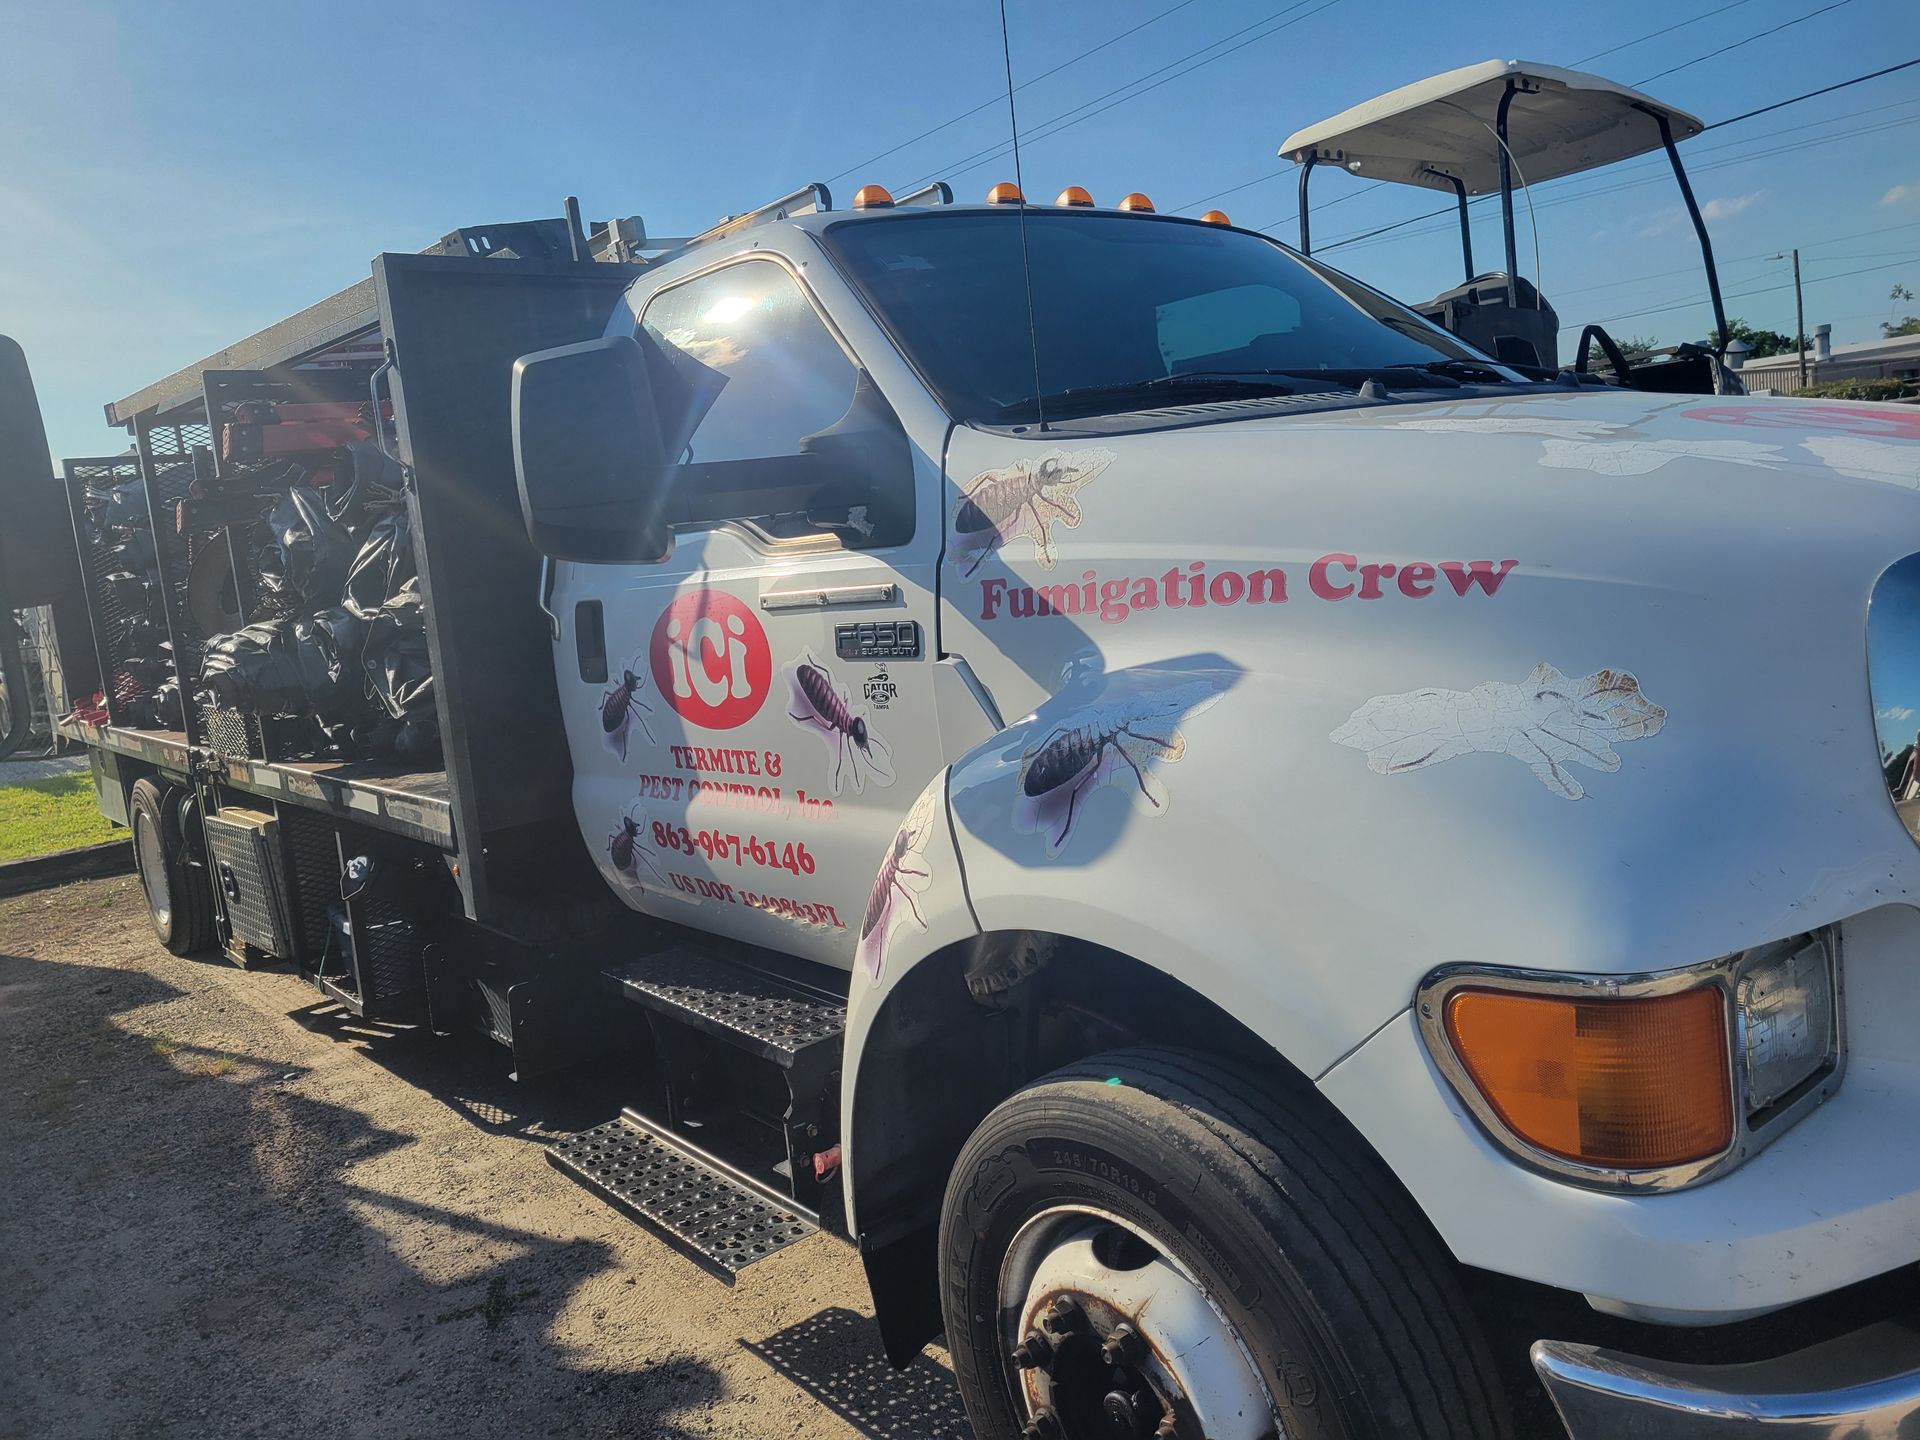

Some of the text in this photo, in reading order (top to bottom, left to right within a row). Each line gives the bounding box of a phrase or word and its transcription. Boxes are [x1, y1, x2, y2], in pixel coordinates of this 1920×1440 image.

[980, 553, 1519, 624] Fumigation Crew
[862, 647, 890, 655] SUPER
[892, 646, 916, 656] DUTY
[863, 683, 898, 700] GATOR
[670, 745, 782, 777] TERMITE &
[639, 774, 839, 821] PEST CONTROL, Inc.
[652, 820, 816, 876] 863-967-6146
[668, 872, 697, 894] US
[694, 877, 737, 903] DOT
